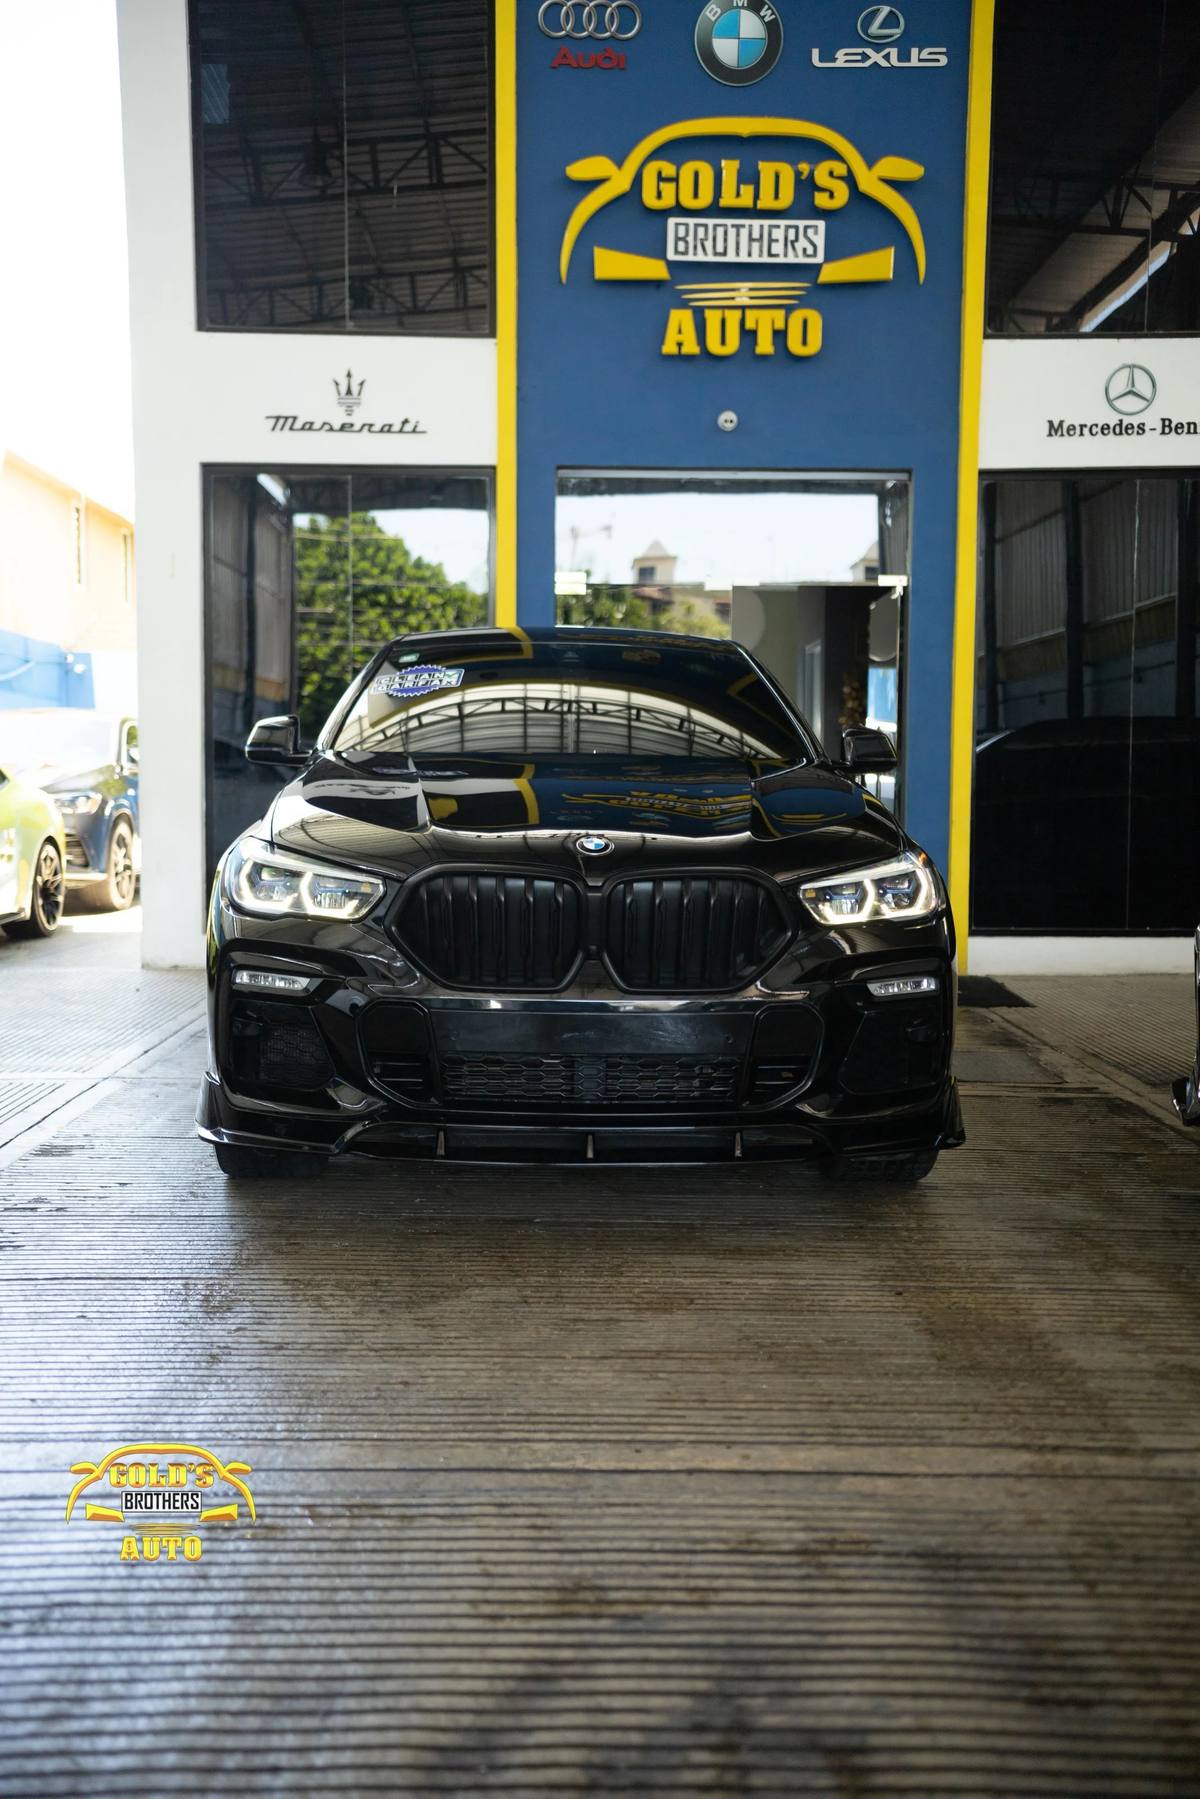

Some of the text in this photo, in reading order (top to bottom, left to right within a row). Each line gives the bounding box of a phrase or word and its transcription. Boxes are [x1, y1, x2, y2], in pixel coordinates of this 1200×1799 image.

[706, 0, 776, 22] BMW
[551, 47, 627, 70] Audi
[811, 47, 948, 68] LEXUS
[641, 159, 850, 211] GOLD'S
[673, 222, 820, 260] BROTHERS
[661, 308, 824, 357] AUTO
[264, 415, 428, 435] Maserati
[1046, 417, 1200, 437] Mercedes-Ben
[379, 671, 445, 685] CLEAN
